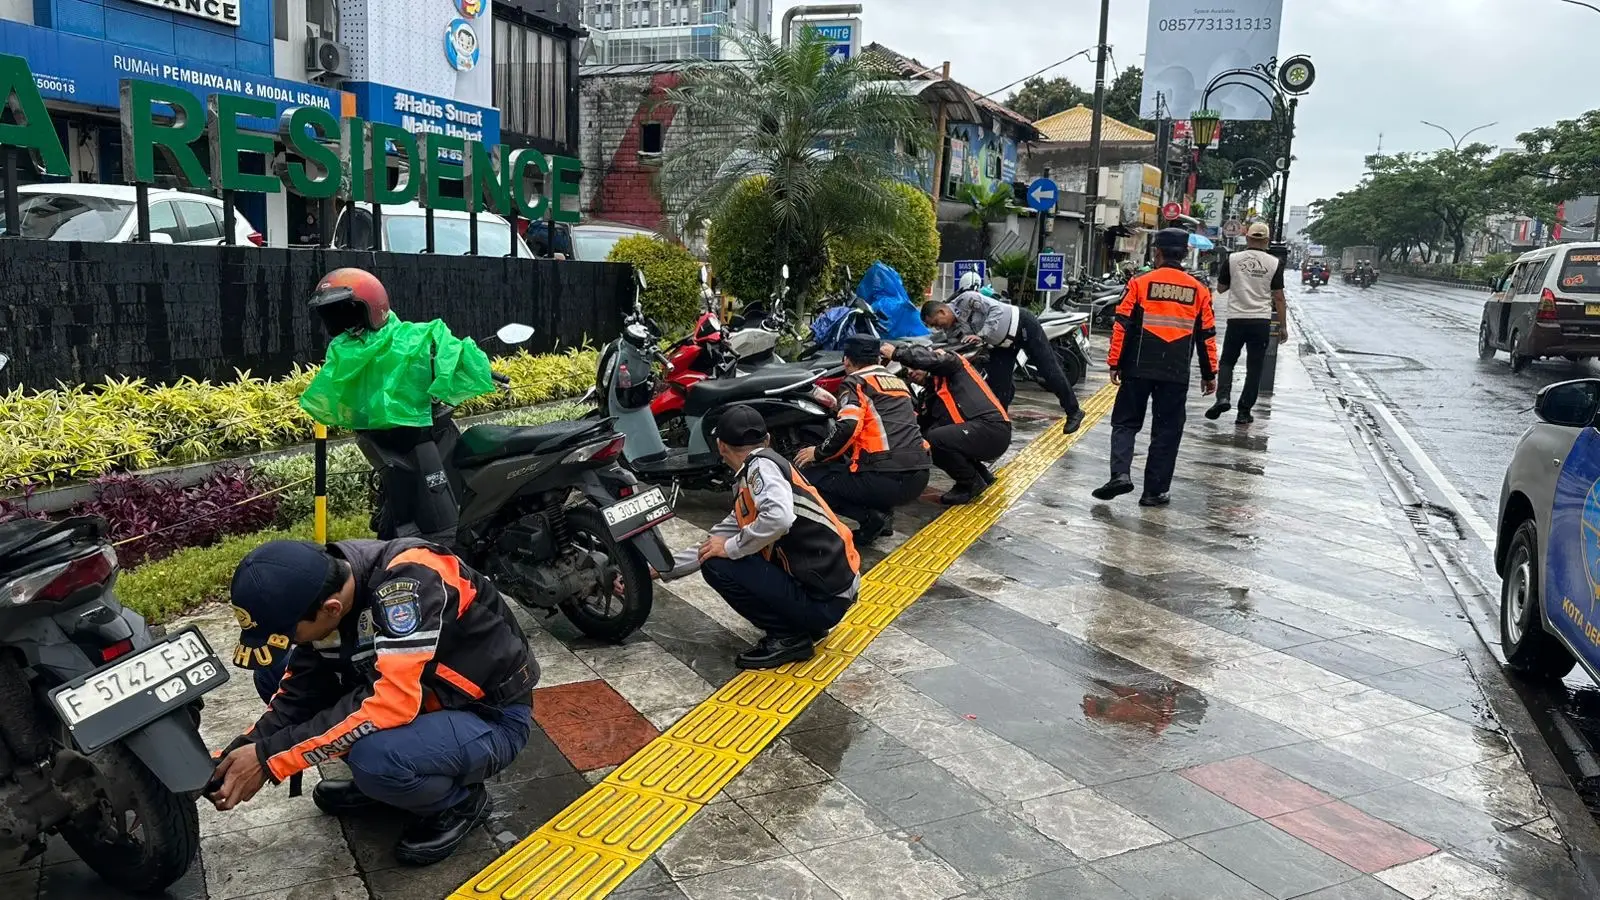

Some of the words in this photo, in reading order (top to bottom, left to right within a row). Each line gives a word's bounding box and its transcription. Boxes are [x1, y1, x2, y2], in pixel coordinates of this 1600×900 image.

[150, 0, 237, 21] NCE
[1158, 17, 1272, 32] 085773131313
[113, 55, 159, 77] RUMAH
[163, 65, 241, 93] PEMBIAYAAN
[245, 82, 254, 95] &
[256, 84, 294, 103] MODAL
[297, 92, 331, 110] USAHA
[394, 92, 443, 118] #Habis
[445, 103, 482, 127] Sunat
[120, 78, 582, 224] RESIDENCE
[1150, 283, 1194, 302] DISHUB
[606, 511, 615, 524] B
[618, 500, 642, 518] 3037
[1562, 596, 1584, 629] KOTA
[232, 633, 290, 667] HUB
[65, 693, 83, 718] F
[93, 661, 154, 701] 5742
[159, 637, 206, 670] FJA
[159, 680, 186, 699] 12
[190, 664, 215, 685] 28
